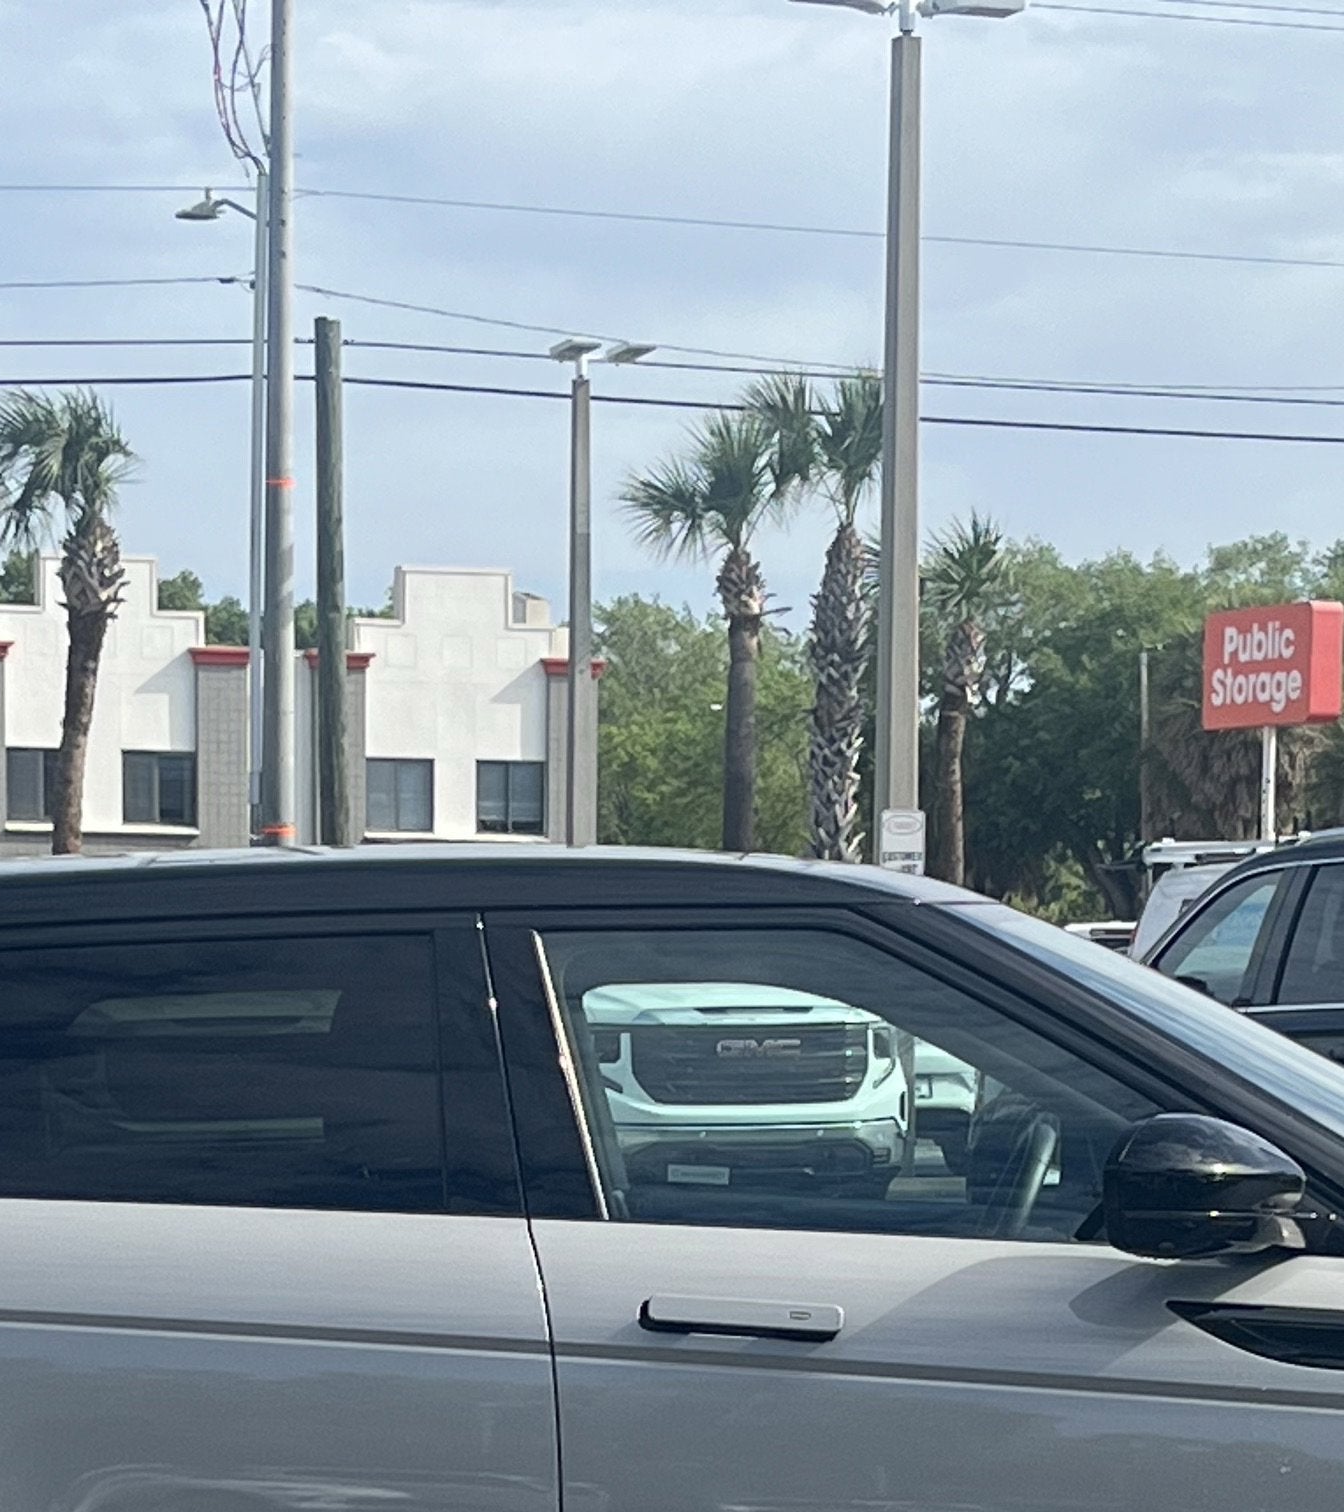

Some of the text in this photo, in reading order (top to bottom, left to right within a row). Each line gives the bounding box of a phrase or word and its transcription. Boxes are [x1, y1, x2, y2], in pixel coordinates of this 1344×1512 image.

[1223, 621, 1296, 664] Public
[1210, 667, 1303, 713] Storage
[716, 1038, 802, 1058] GMC
